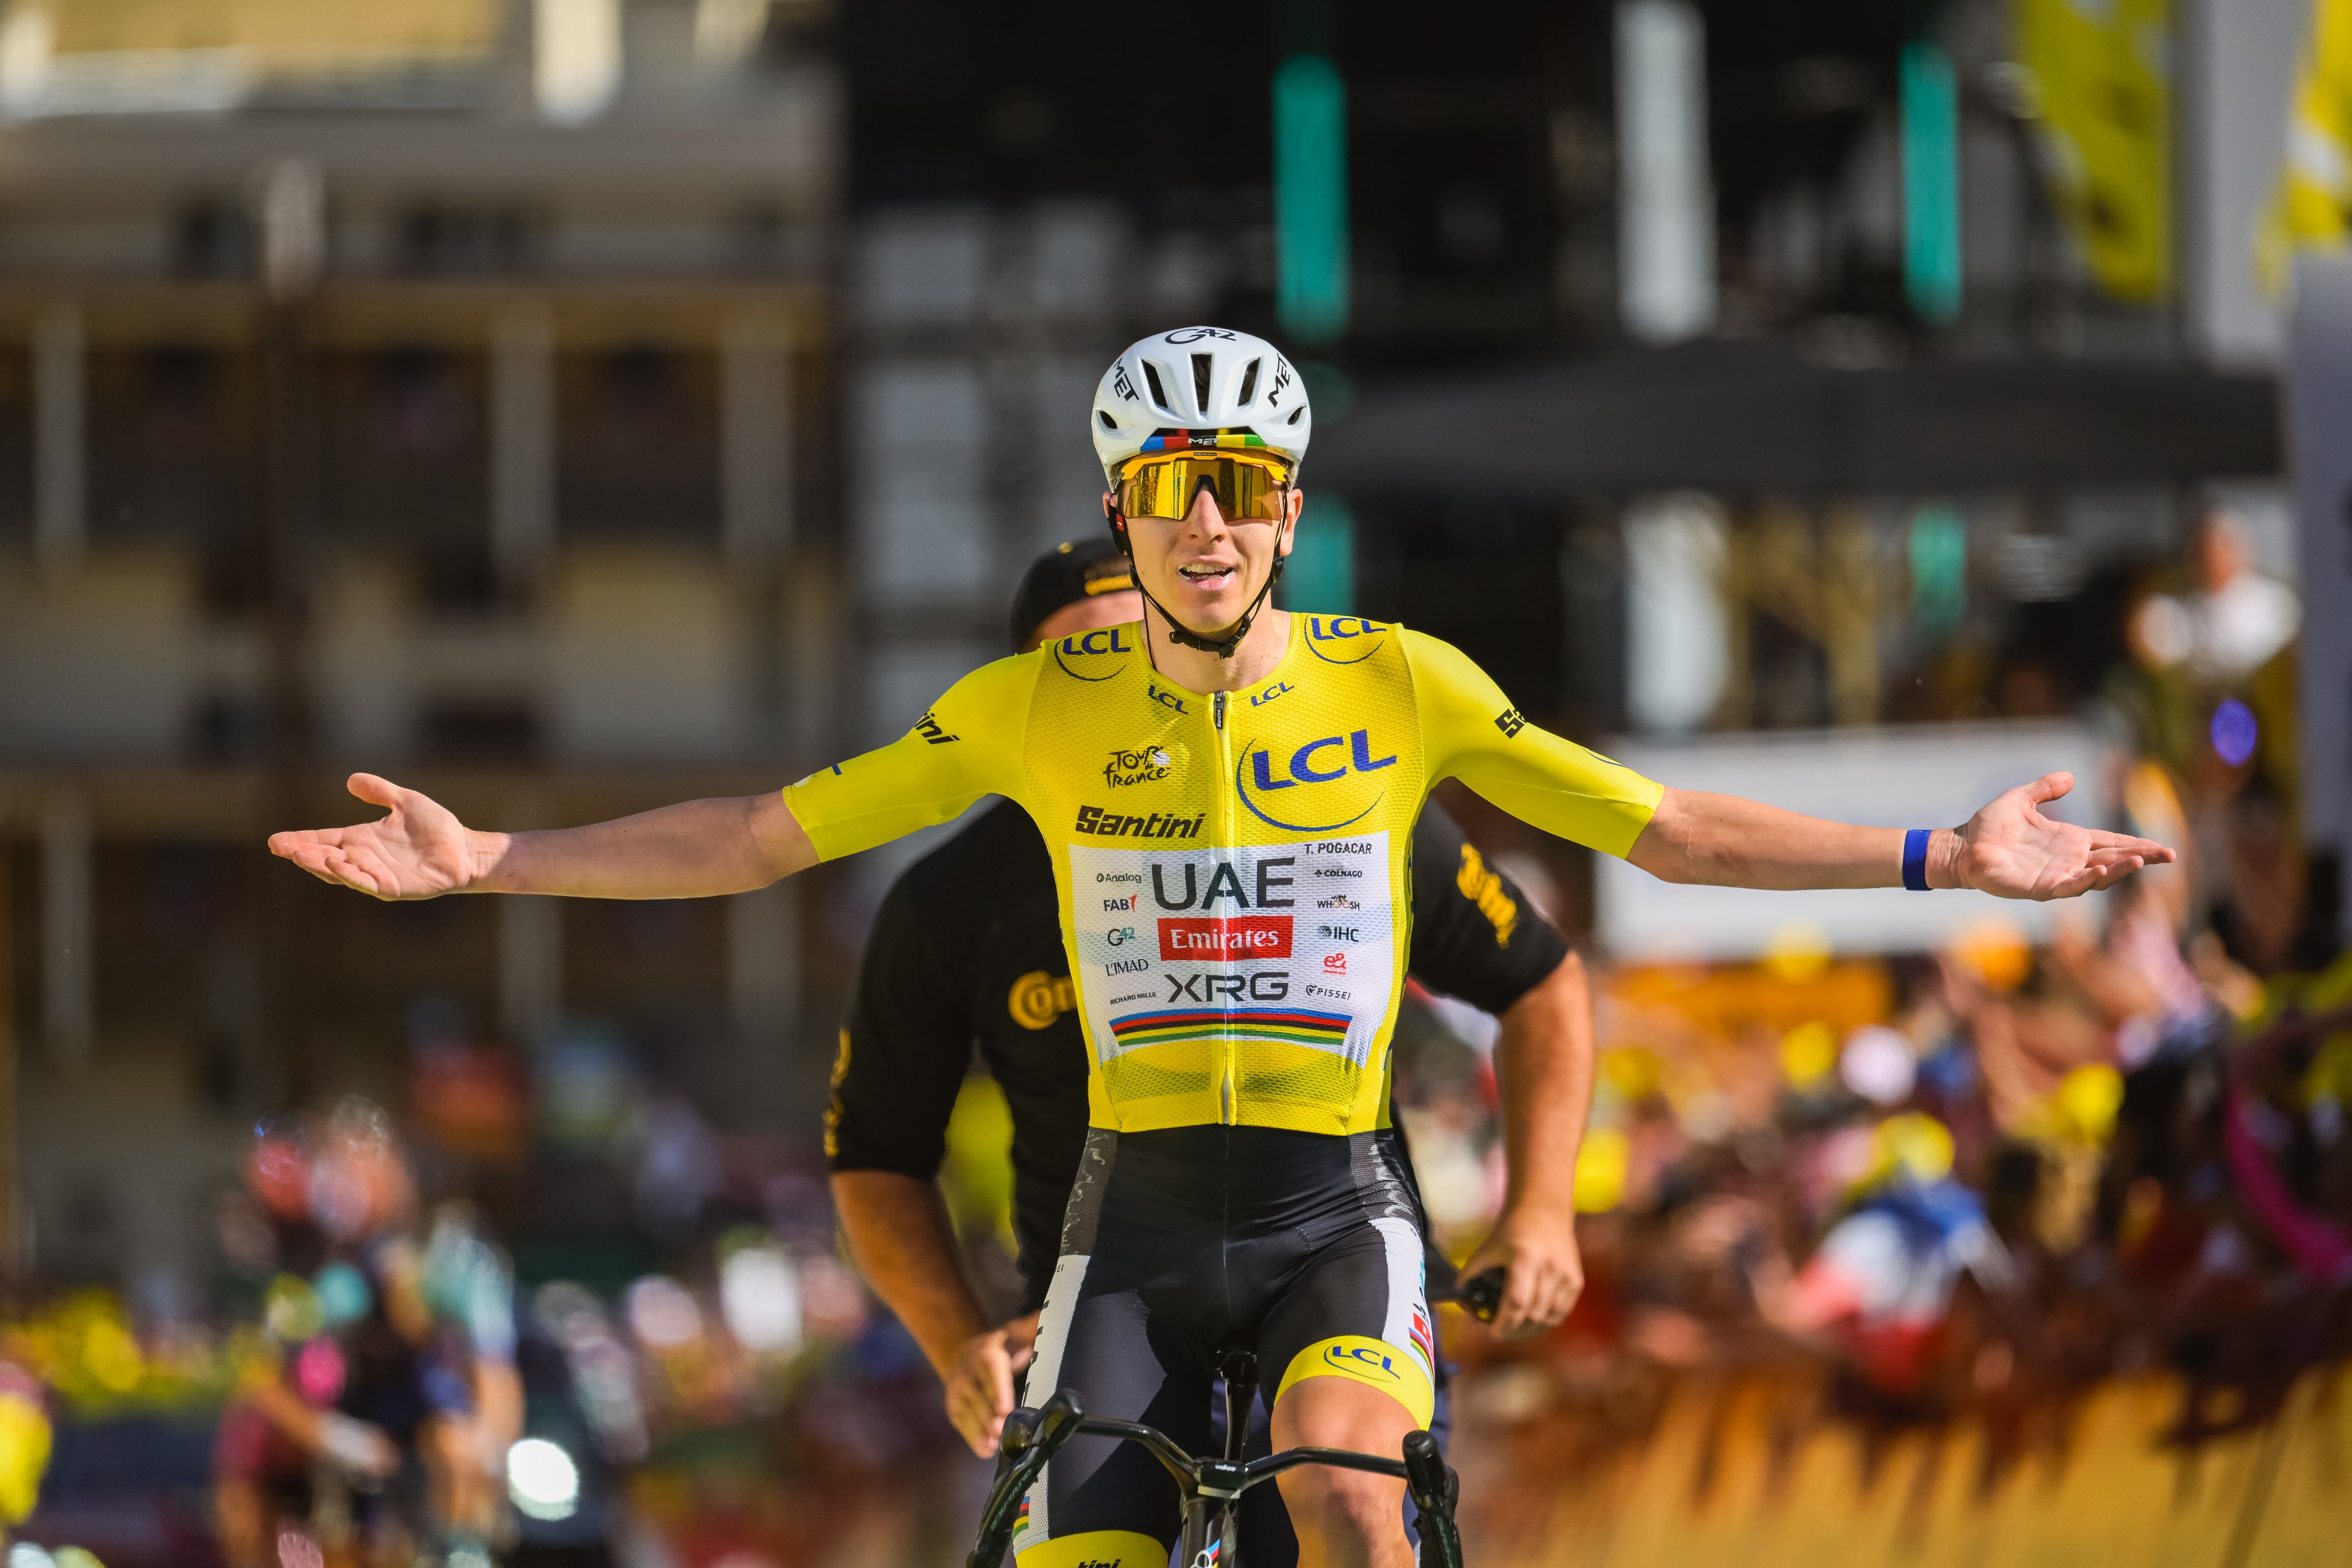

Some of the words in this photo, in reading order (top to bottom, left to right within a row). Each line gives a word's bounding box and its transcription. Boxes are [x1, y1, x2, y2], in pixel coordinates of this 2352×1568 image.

[1113, 357, 1139, 401] MET
[1267, 352, 1290, 408] MET
[1312, 617, 1387, 640] LCL
[1063, 629, 1131, 655] LCL
[1148, 684, 1189, 715] LCL
[1251, 682, 1294, 706] LCL
[1145, 761, 1154, 770] de
[1252, 729, 1397, 791] LCL
[1076, 805, 1206, 838] Santini
[1305, 843, 1314, 854] T.
[1318, 842, 1372, 854] POGACAR
[1105, 873, 1142, 884] Analog
[1152, 857, 1295, 911] UAE
[1324, 870, 1363, 878] COLNAGO
[1108, 927, 1136, 946] G42
[1170, 928, 1279, 950] Emirates
[1333, 926, 1359, 942] IHC
[1105, 959, 1149, 977] L'IMAD
[1164, 972, 1289, 1002] XRG
[1317, 988, 1351, 1000] PISSEI
[1110, 994, 1136, 1005] RICHARD
[1332, 1346, 1401, 1379] LCL
